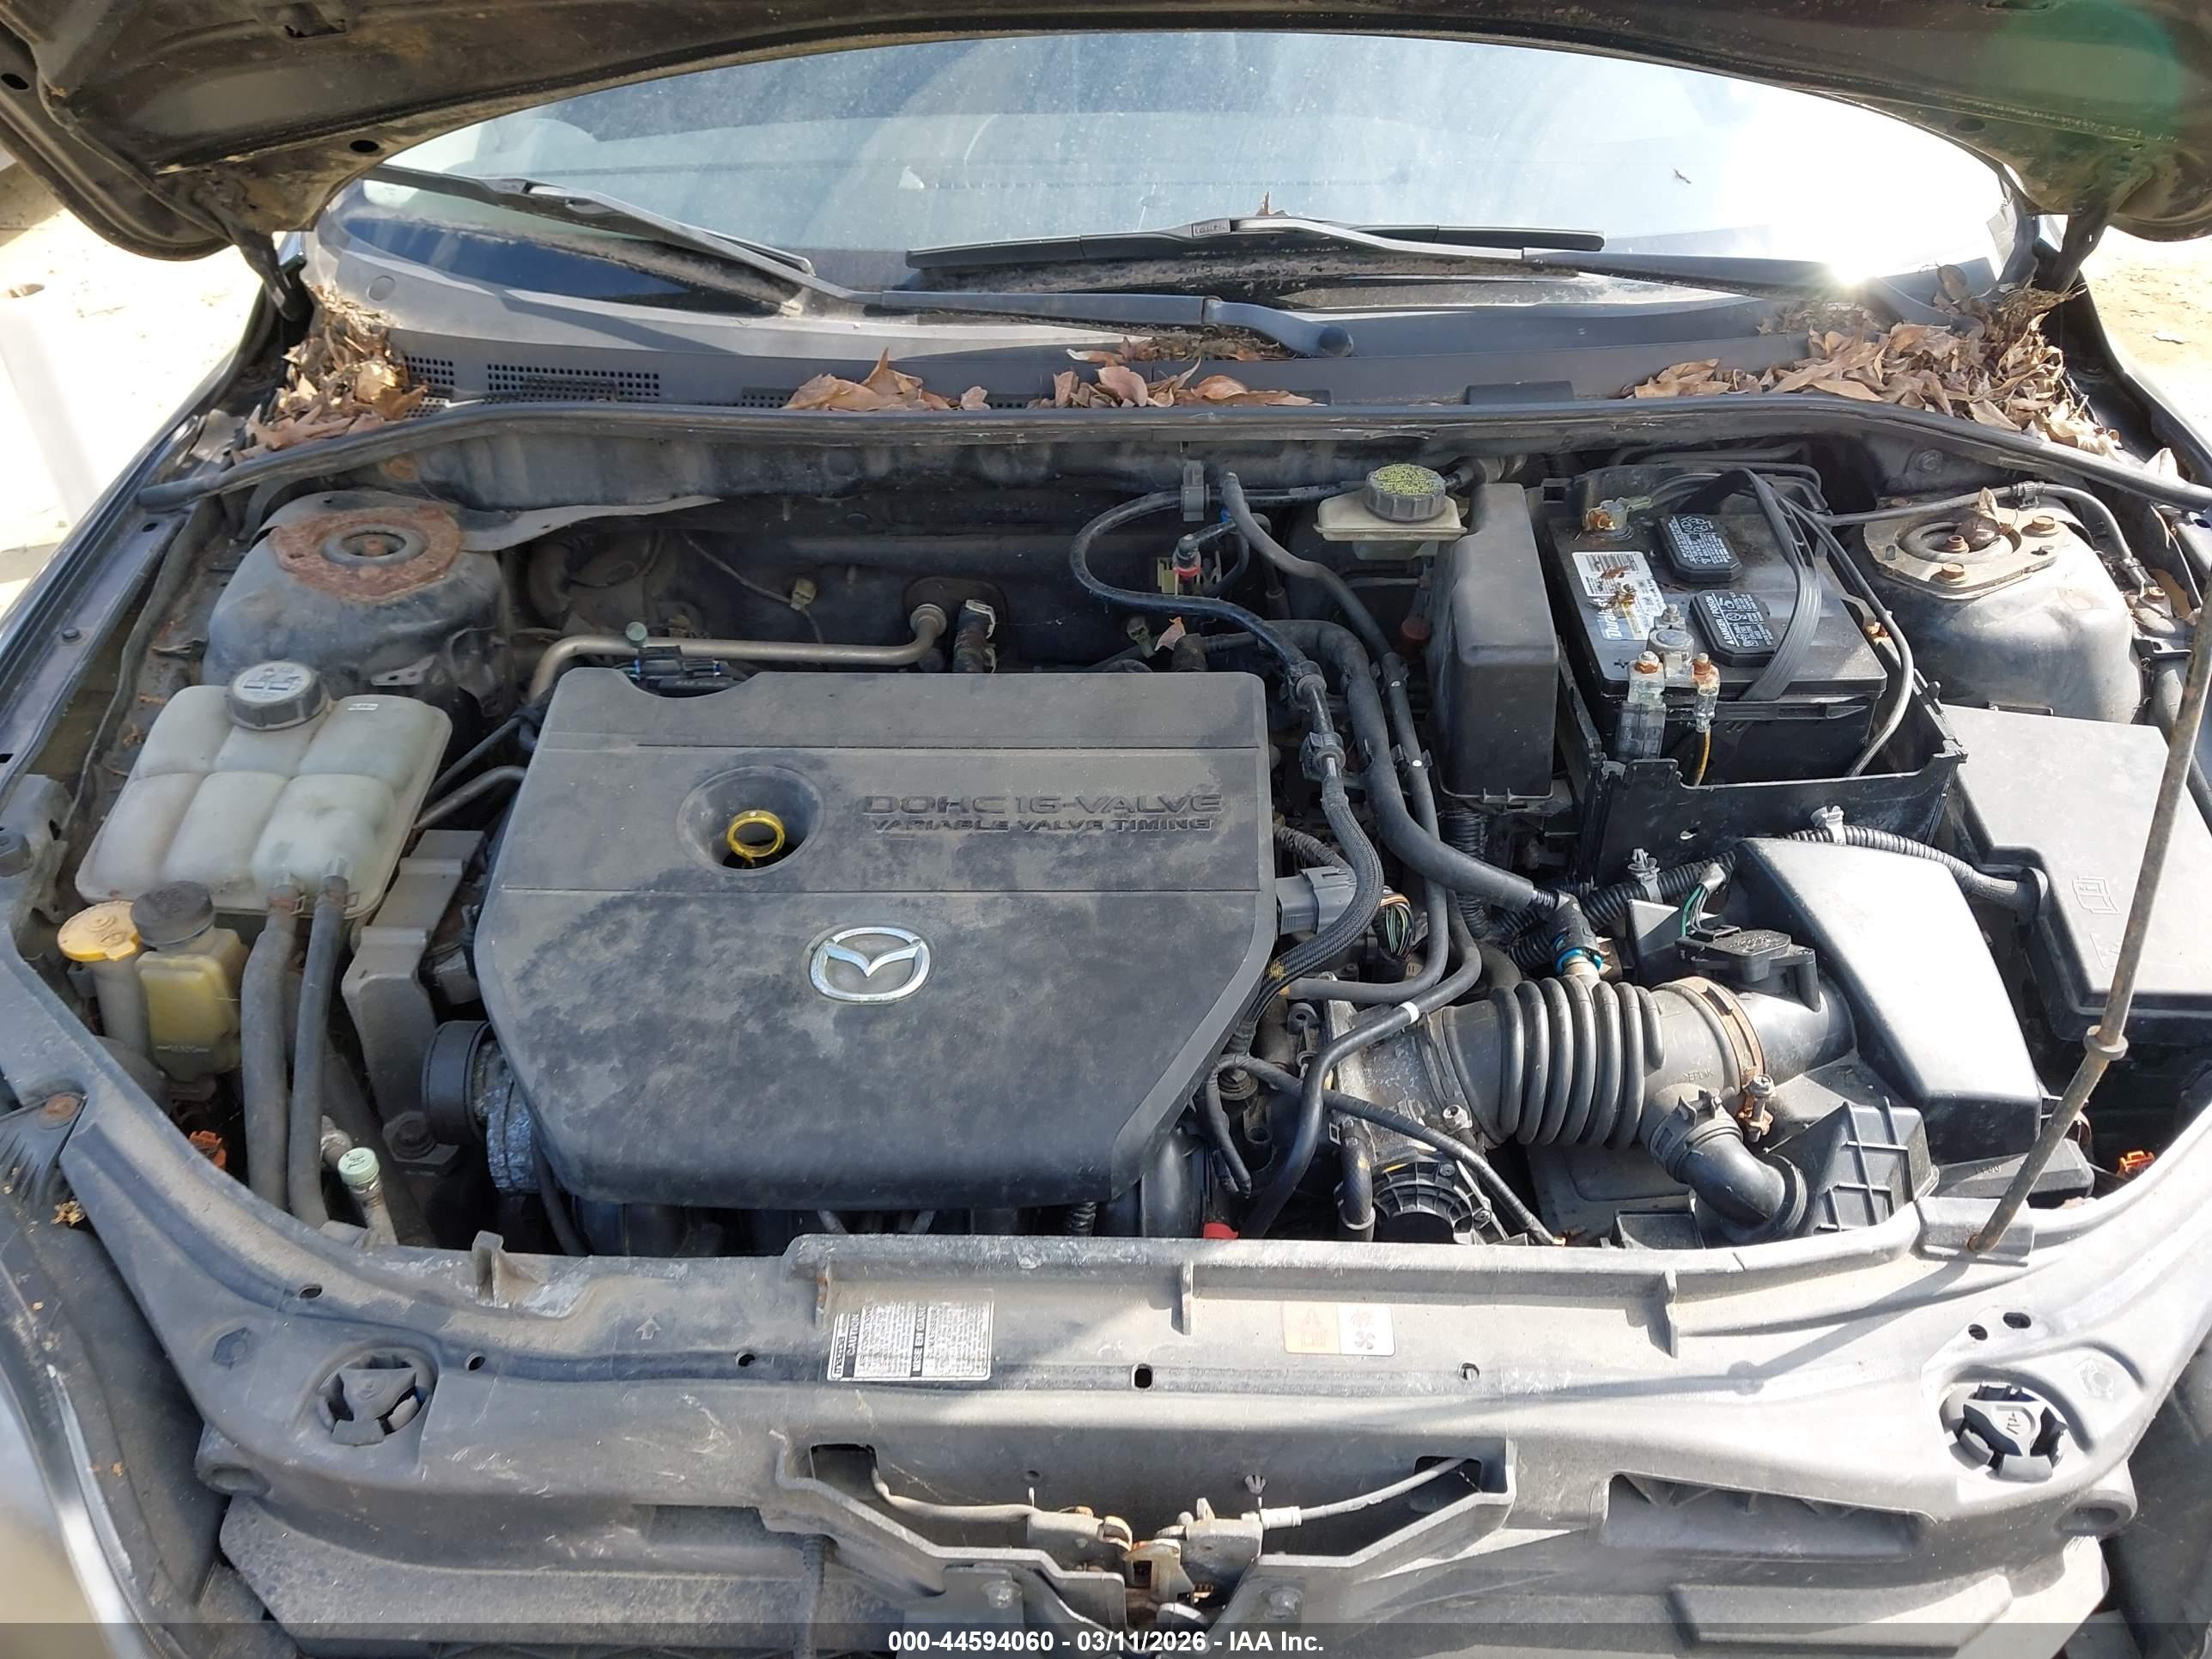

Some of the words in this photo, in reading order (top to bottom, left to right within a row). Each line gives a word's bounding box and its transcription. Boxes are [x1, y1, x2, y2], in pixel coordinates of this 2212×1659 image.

[862, 795, 1008, 815] DOHC
[871, 819, 1010, 832] VARIABLE
[1017, 819, 1105, 831] VALVE
[1115, 818, 1212, 831] TIMING
[846, 1312, 860, 1356] CAUTION
[915, 1332, 925, 1346] EN
